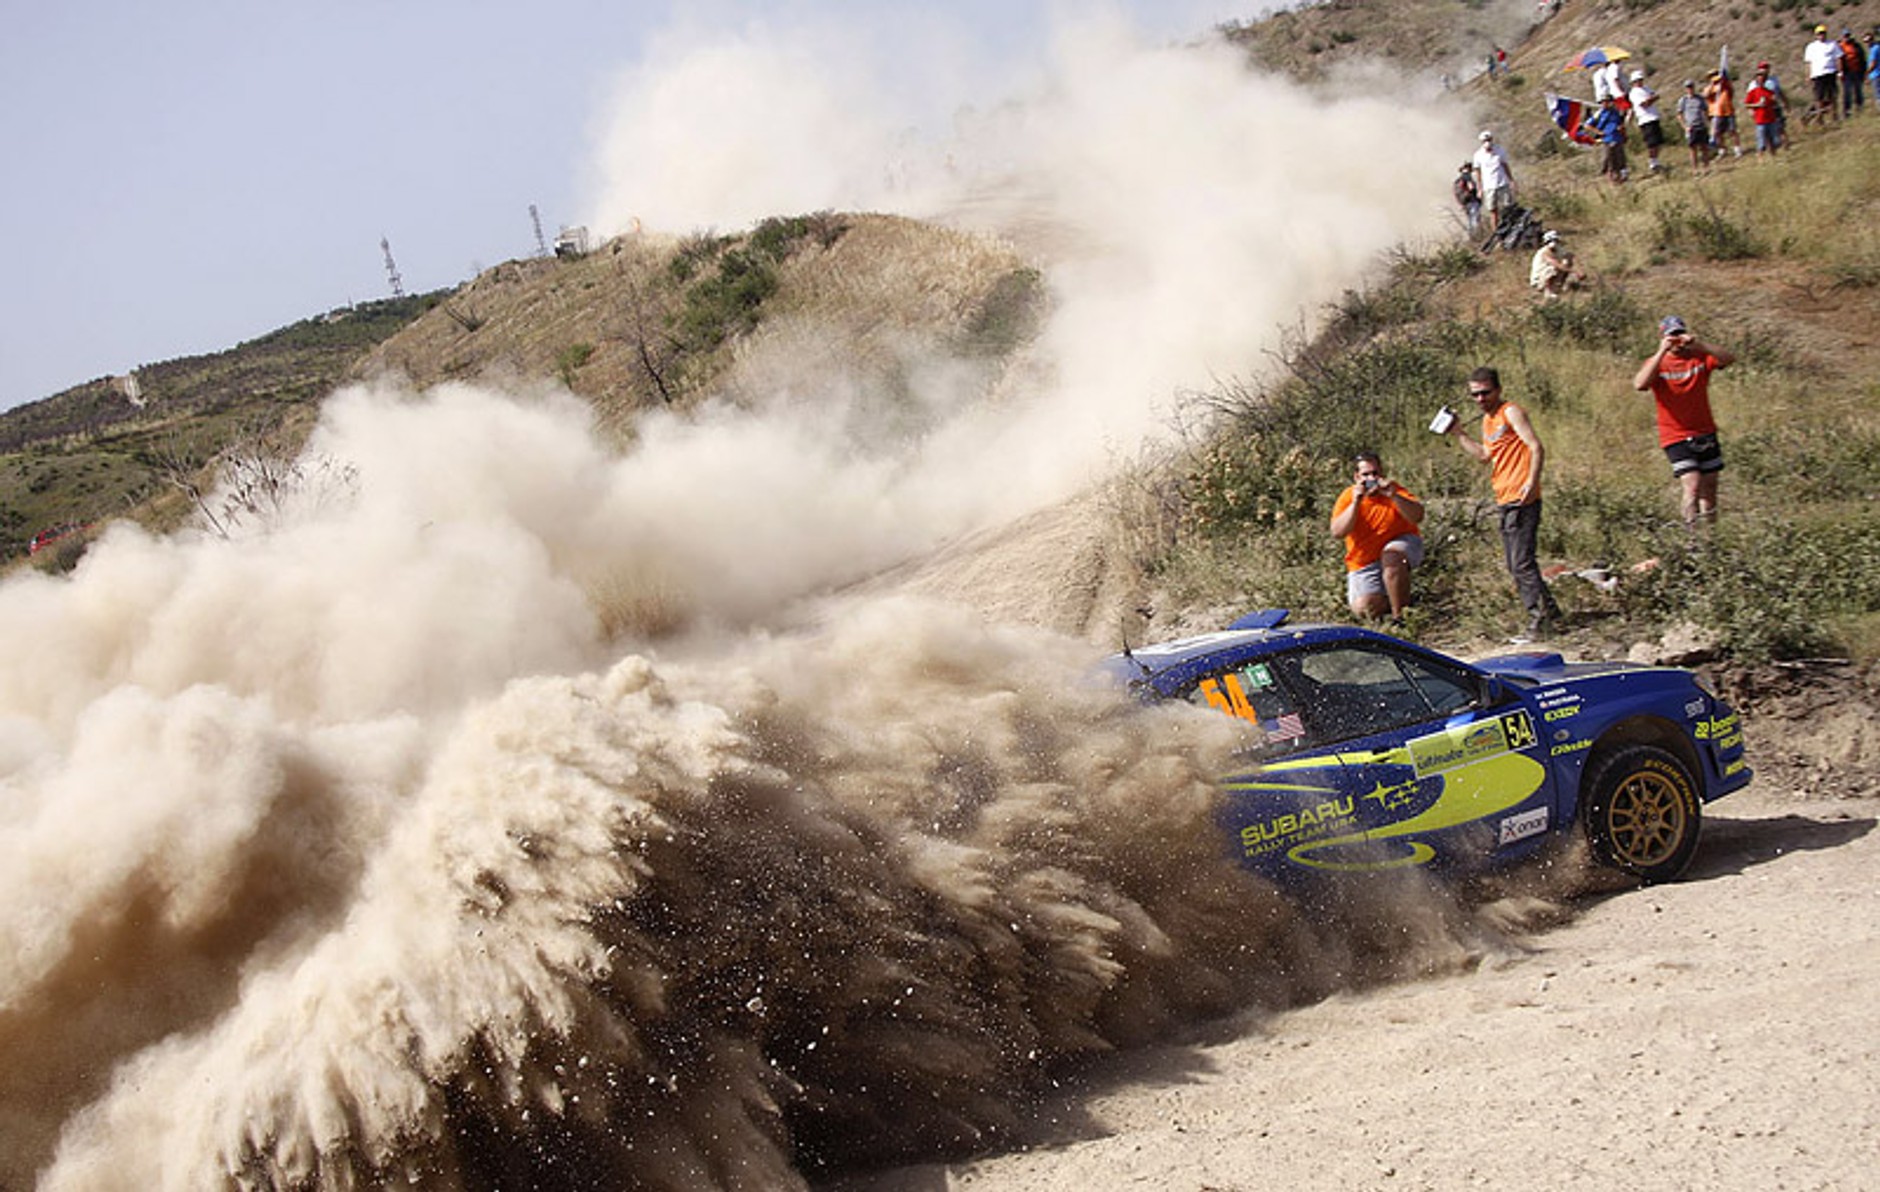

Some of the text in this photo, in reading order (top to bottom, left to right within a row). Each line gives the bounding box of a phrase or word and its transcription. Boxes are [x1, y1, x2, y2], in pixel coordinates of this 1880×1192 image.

[1199, 673, 1258, 726] 54
[1506, 714, 1532, 747] 54
[1241, 795, 1355, 846] SUBARU
[1245, 838, 1285, 857] RALLY
